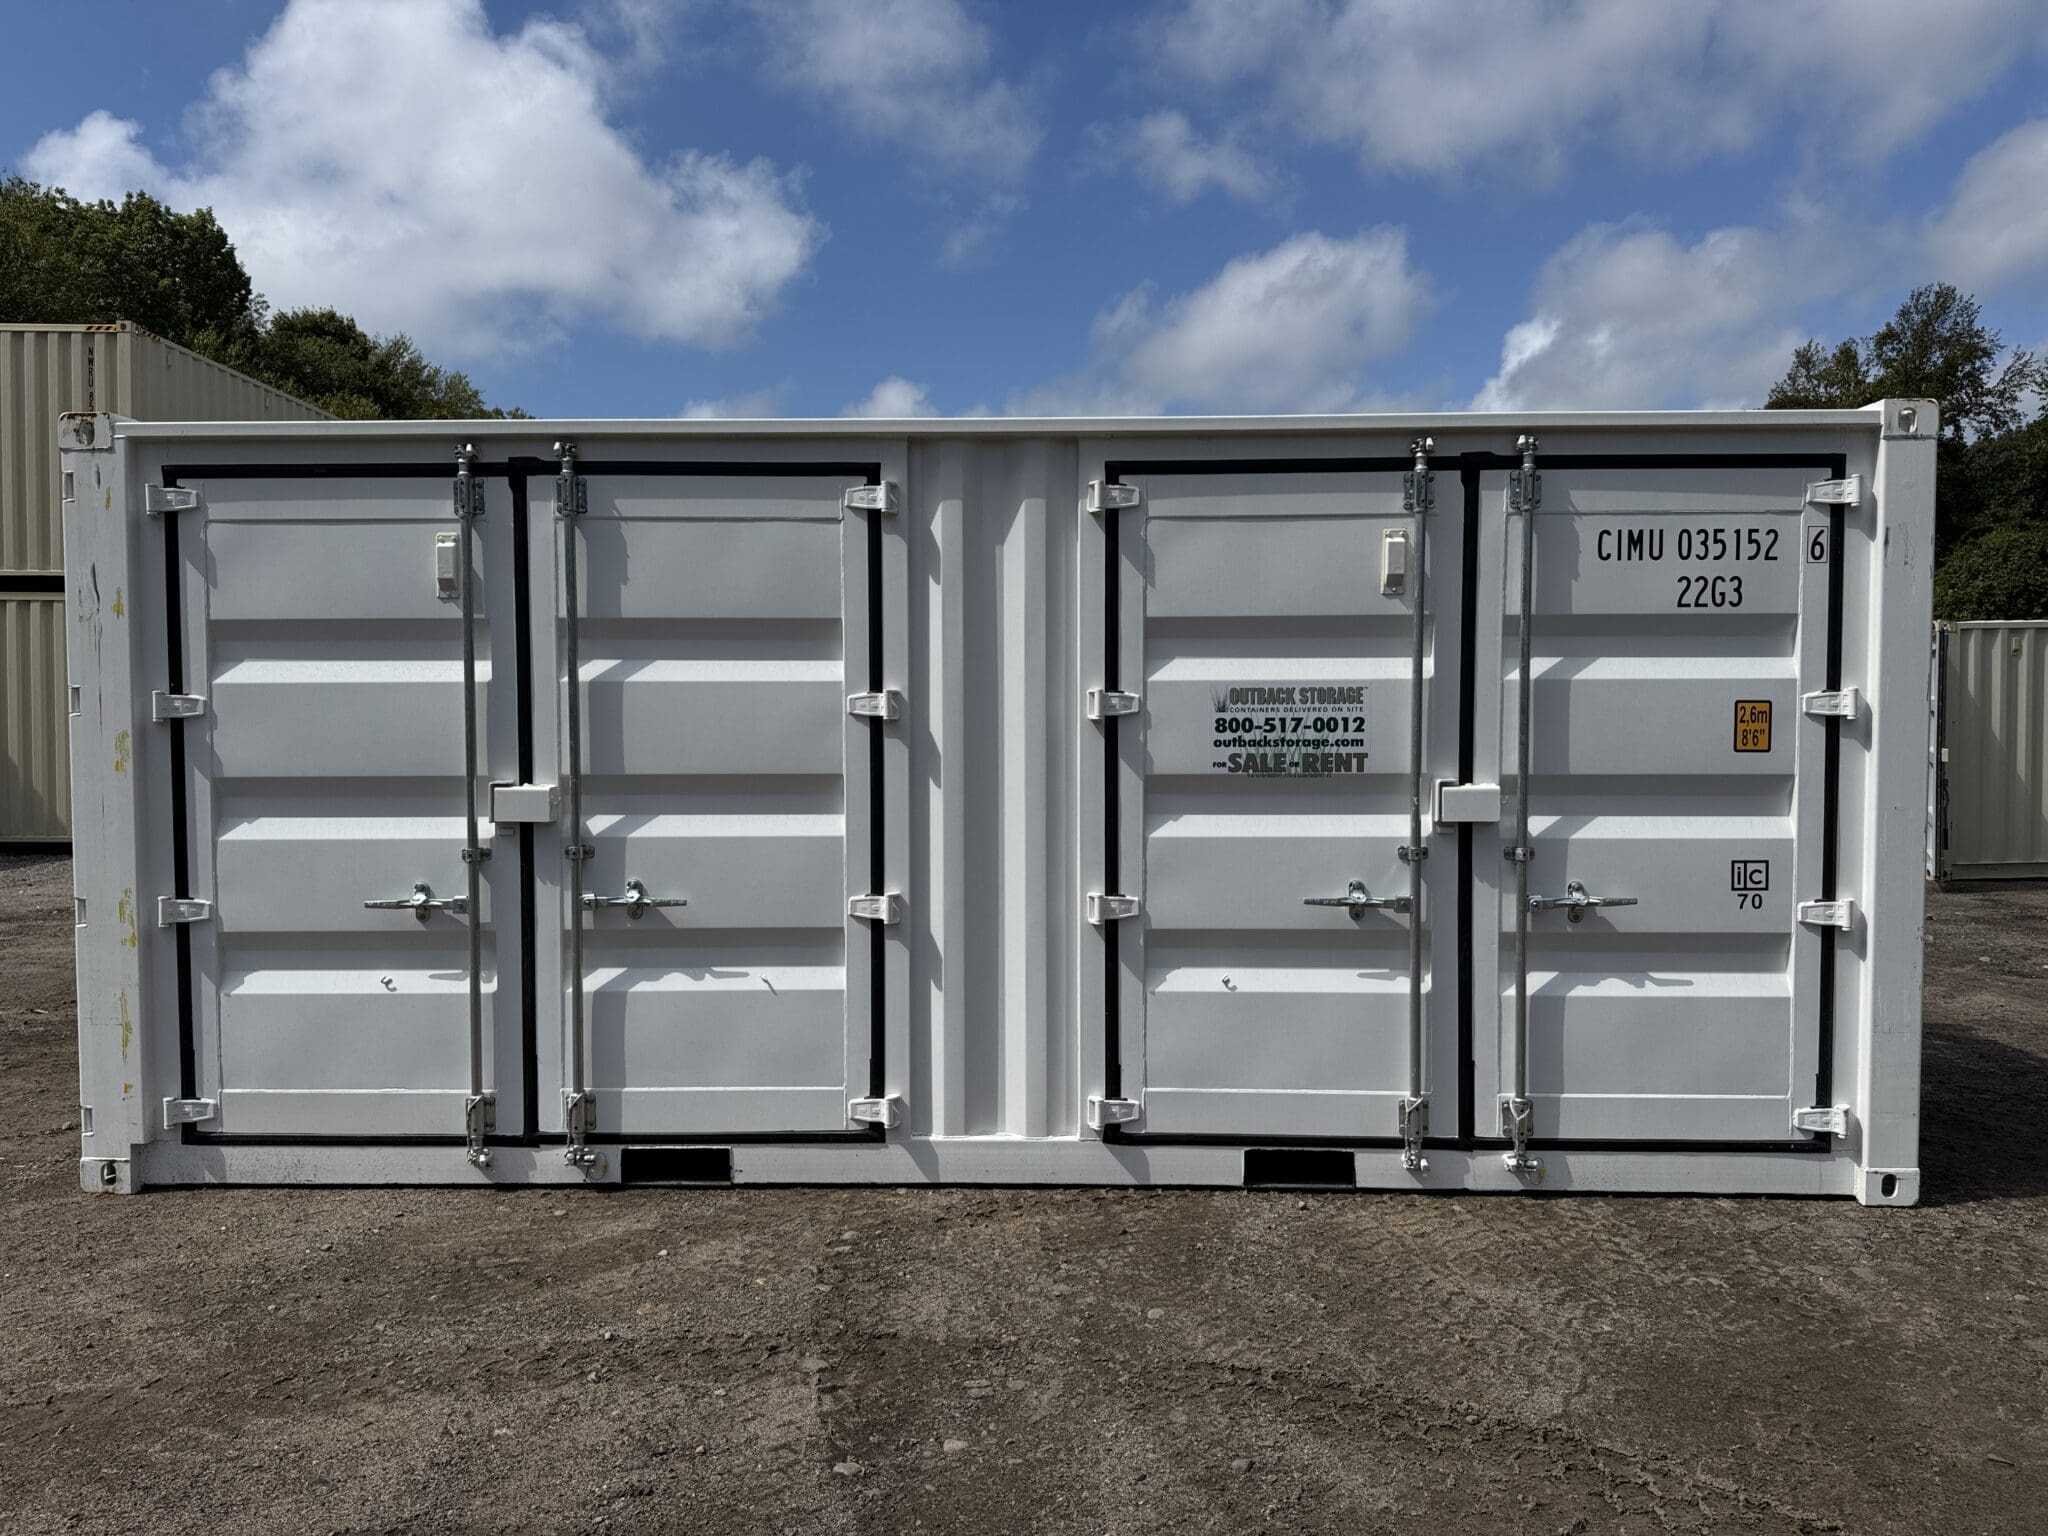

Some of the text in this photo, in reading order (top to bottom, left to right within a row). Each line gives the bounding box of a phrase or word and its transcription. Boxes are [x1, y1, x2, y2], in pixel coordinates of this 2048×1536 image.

[1597, 528, 1825, 561] CIMU 035152 6
[1676, 575, 1743, 608] 22G3
[1229, 686, 1364, 705] OUTBACK STORAGE
[1214, 717, 1365, 733] 800-517-0012
[1213, 735, 1364, 750] outbackstorage.com
[1227, 752, 1287, 773] SALE
[1302, 752, 1369, 773] RENT
[1737, 893, 1763, 909] 70
